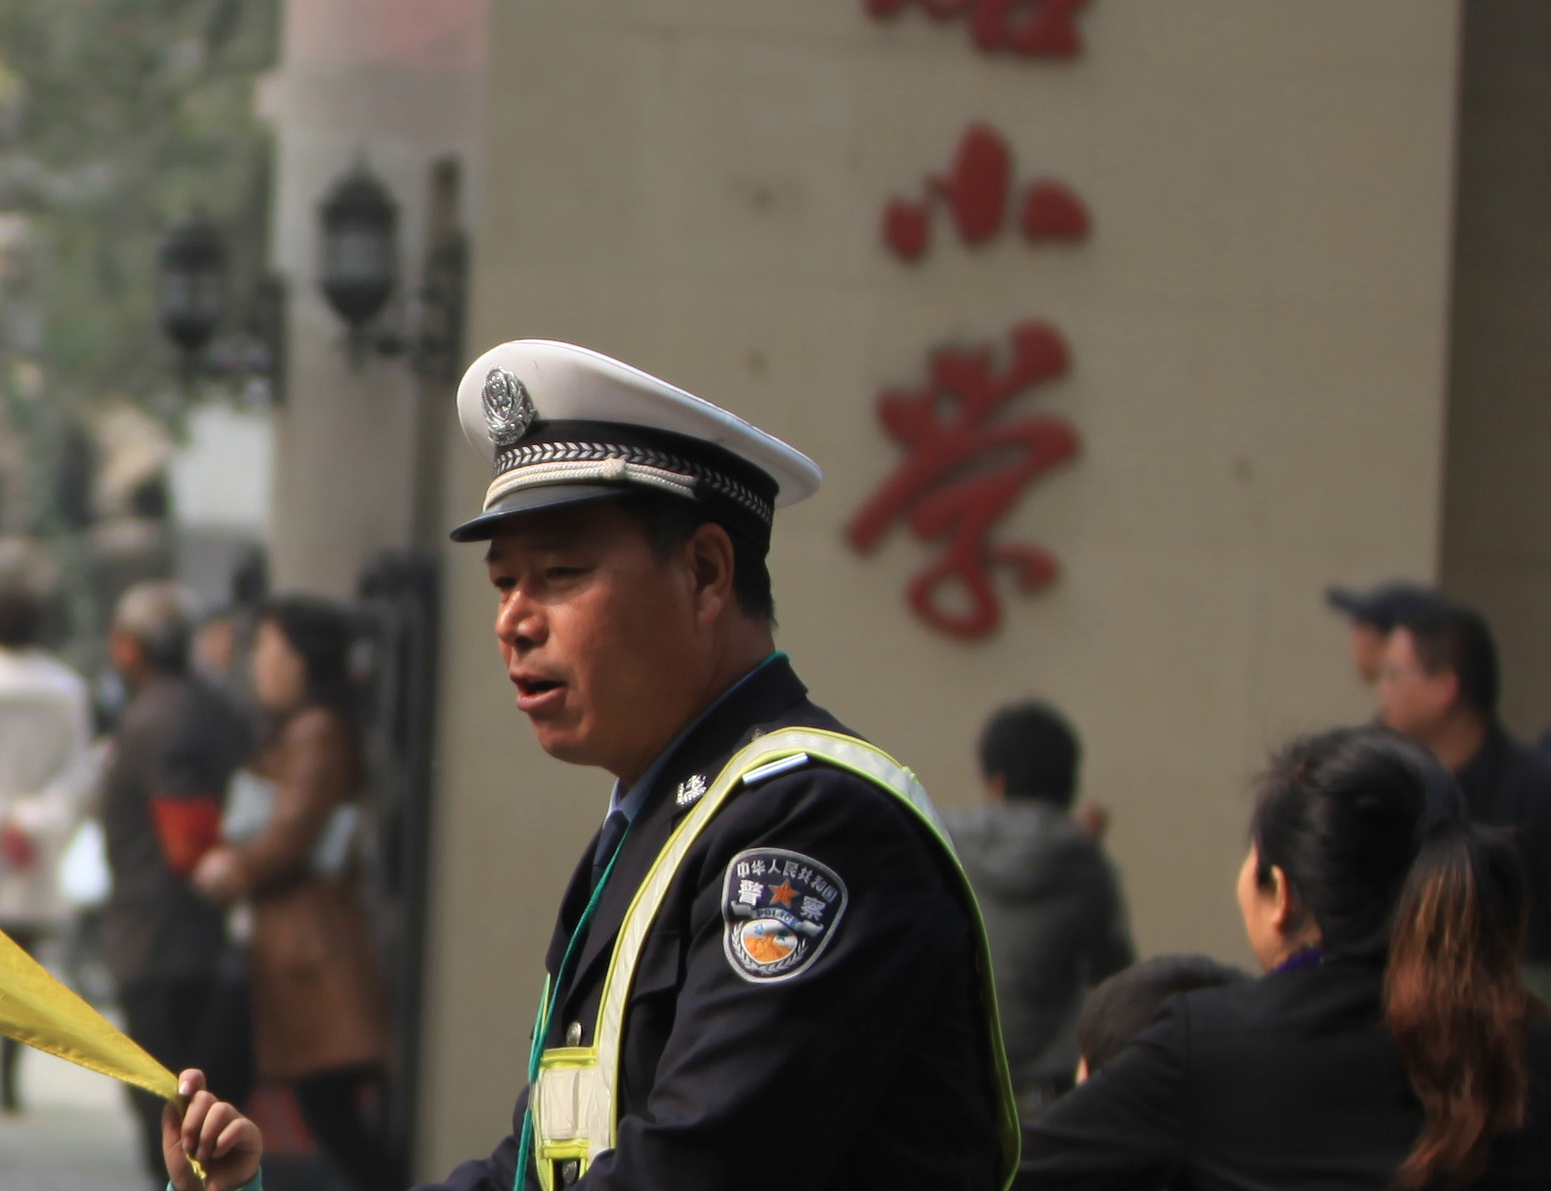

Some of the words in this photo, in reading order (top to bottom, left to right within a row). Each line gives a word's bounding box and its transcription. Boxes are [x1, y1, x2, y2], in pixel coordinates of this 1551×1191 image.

[736, 858, 839, 904] 中华人民共和国
